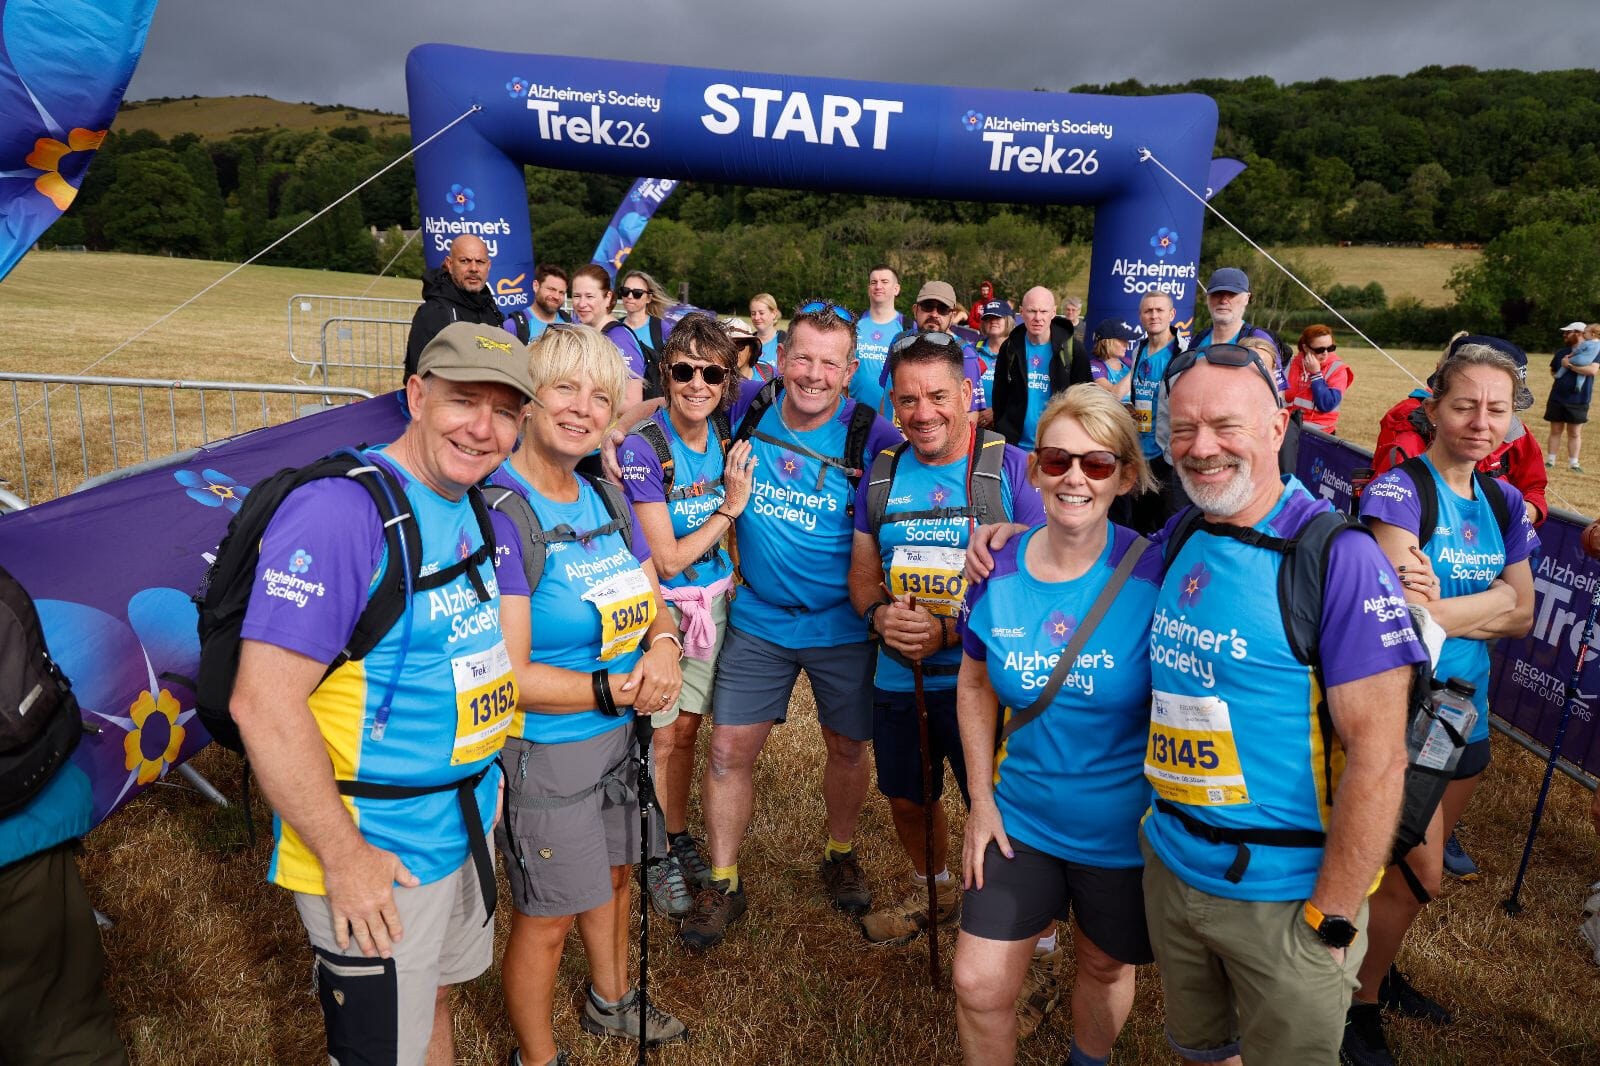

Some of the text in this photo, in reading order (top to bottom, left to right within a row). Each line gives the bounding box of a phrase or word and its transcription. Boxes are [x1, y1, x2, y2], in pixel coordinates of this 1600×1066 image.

[528, 84, 661, 112] Alzheimer's Society
[701, 83, 903, 150] START
[983, 116, 1113, 139] Alzheimer's Society
[643, 179, 676, 203] Tre
[425, 216, 511, 235] Alzheimer's
[1112, 258, 1196, 279] Alzheimer's
[493, 293, 528, 307] OORS
[1123, 276, 1186, 300] Society
[1027, 380, 1049, 393] ciety
[1135, 387, 1154, 399] ociety
[623, 472, 645, 482] ociety
[1321, 468, 1353, 496] Alzheime
[673, 495, 725, 515] Alzheime
[752, 477, 837, 512] lzheimer's
[754, 495, 817, 531] Society
[895, 516, 977, 528] Alzheimer
[905, 525, 961, 546] Society
[564, 547, 632, 582] Alzheimer's
[1450, 564, 1497, 586] Society
[1537, 555, 1597, 594] Alzhei
[262, 568, 325, 597] Alzheimer's
[265, 581, 309, 608] Society
[898, 572, 962, 597] 13150
[447, 604, 499, 643] Society
[612, 600, 649, 634] 13147
[1532, 577, 1600, 662] Tre
[1151, 607, 1248, 660] zheimer's
[1003, 648, 1115, 671] Alzheer's
[1150, 634, 1216, 689] Society
[1021, 670, 1094, 696] Soety
[1514, 659, 1566, 697] REGATTA
[469, 680, 515, 726] 13152
[1511, 672, 1592, 722] GREAT OUTDORS
[1152, 732, 1220, 770] 13145
